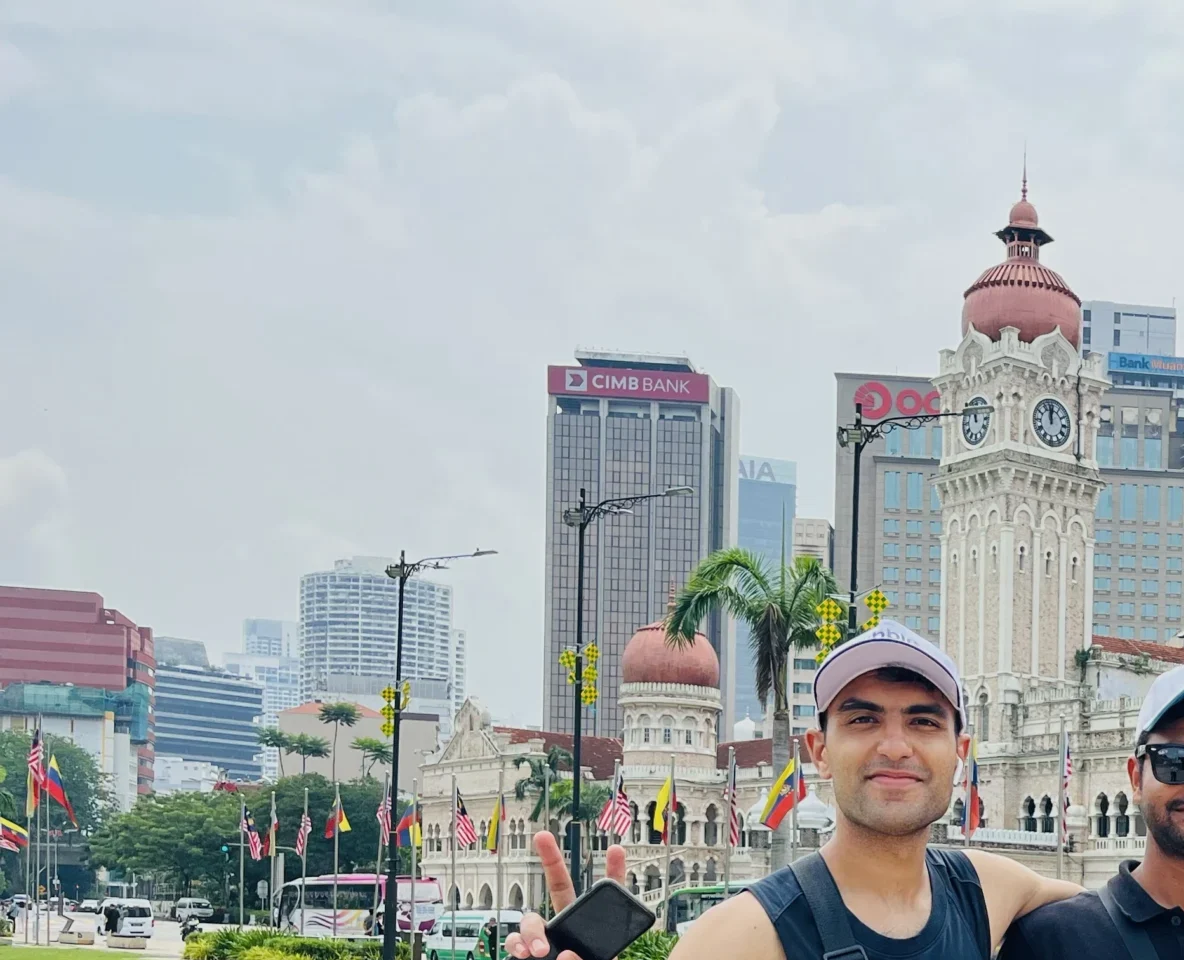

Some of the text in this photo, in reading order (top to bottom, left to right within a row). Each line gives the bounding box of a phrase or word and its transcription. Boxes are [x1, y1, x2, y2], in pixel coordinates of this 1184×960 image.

[1119, 356, 1150, 370] Bank
[591, 374, 691, 394] CIMB BANK
